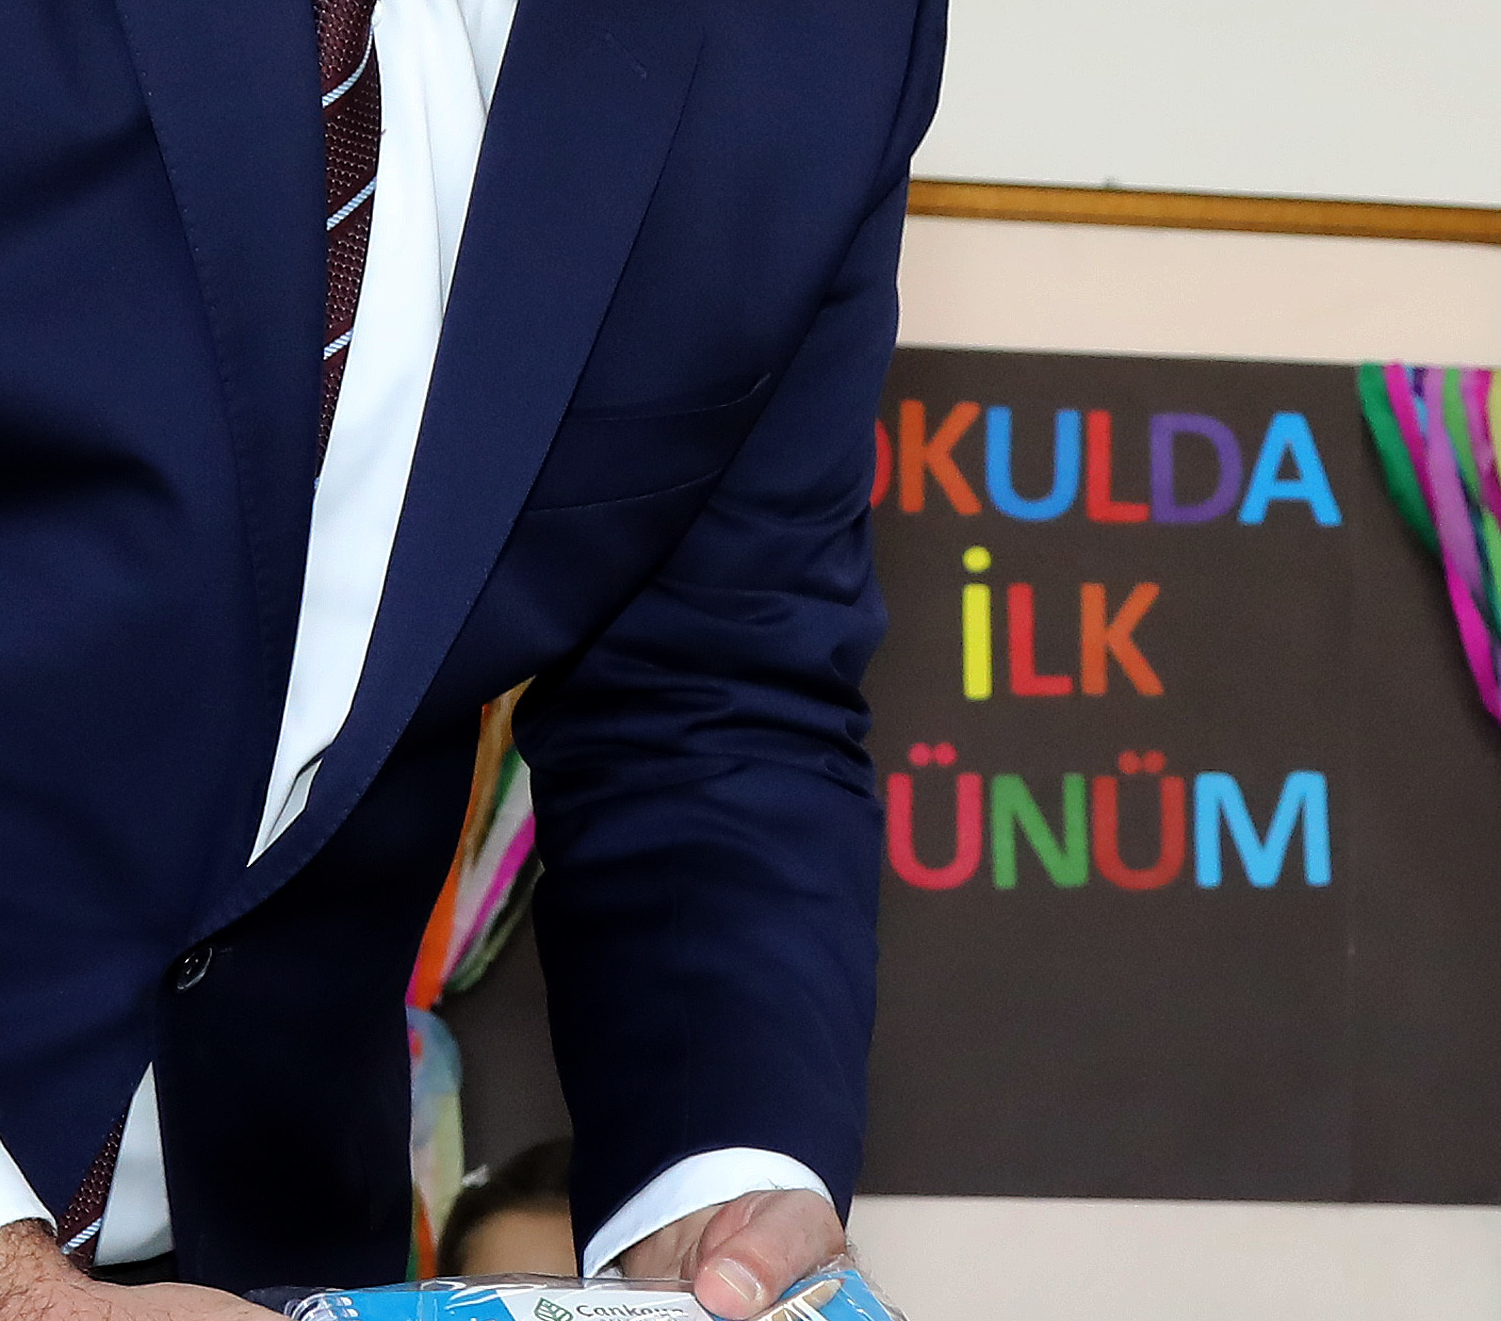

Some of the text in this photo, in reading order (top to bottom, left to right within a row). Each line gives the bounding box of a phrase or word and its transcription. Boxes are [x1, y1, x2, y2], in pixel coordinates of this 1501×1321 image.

[870, 399, 1342, 527] KULDA
[962, 545, 1165, 701] İLK
[886, 742, 1332, 890] ÜNÜM
